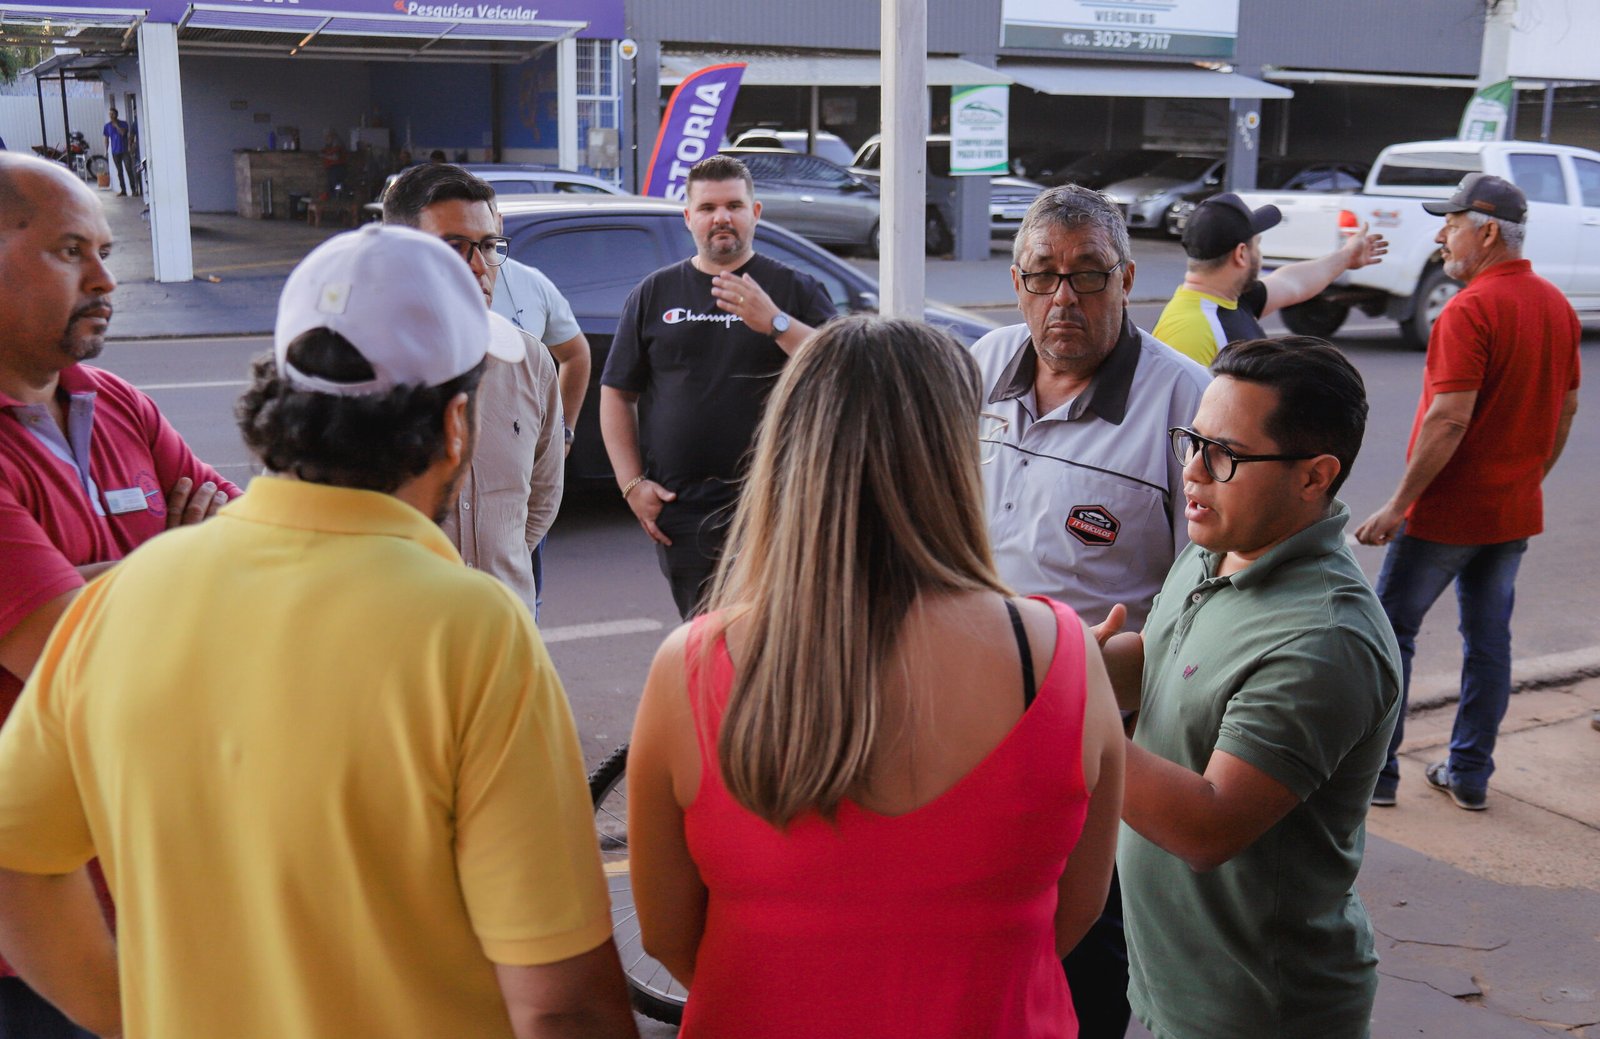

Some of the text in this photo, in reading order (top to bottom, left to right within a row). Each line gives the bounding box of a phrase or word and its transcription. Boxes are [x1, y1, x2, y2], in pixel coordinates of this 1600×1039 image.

[407, 2, 539, 20] Pesquisa Veicular
[1093, 31, 1171, 50] 3029-9717
[662, 307, 743, 329] Champ
